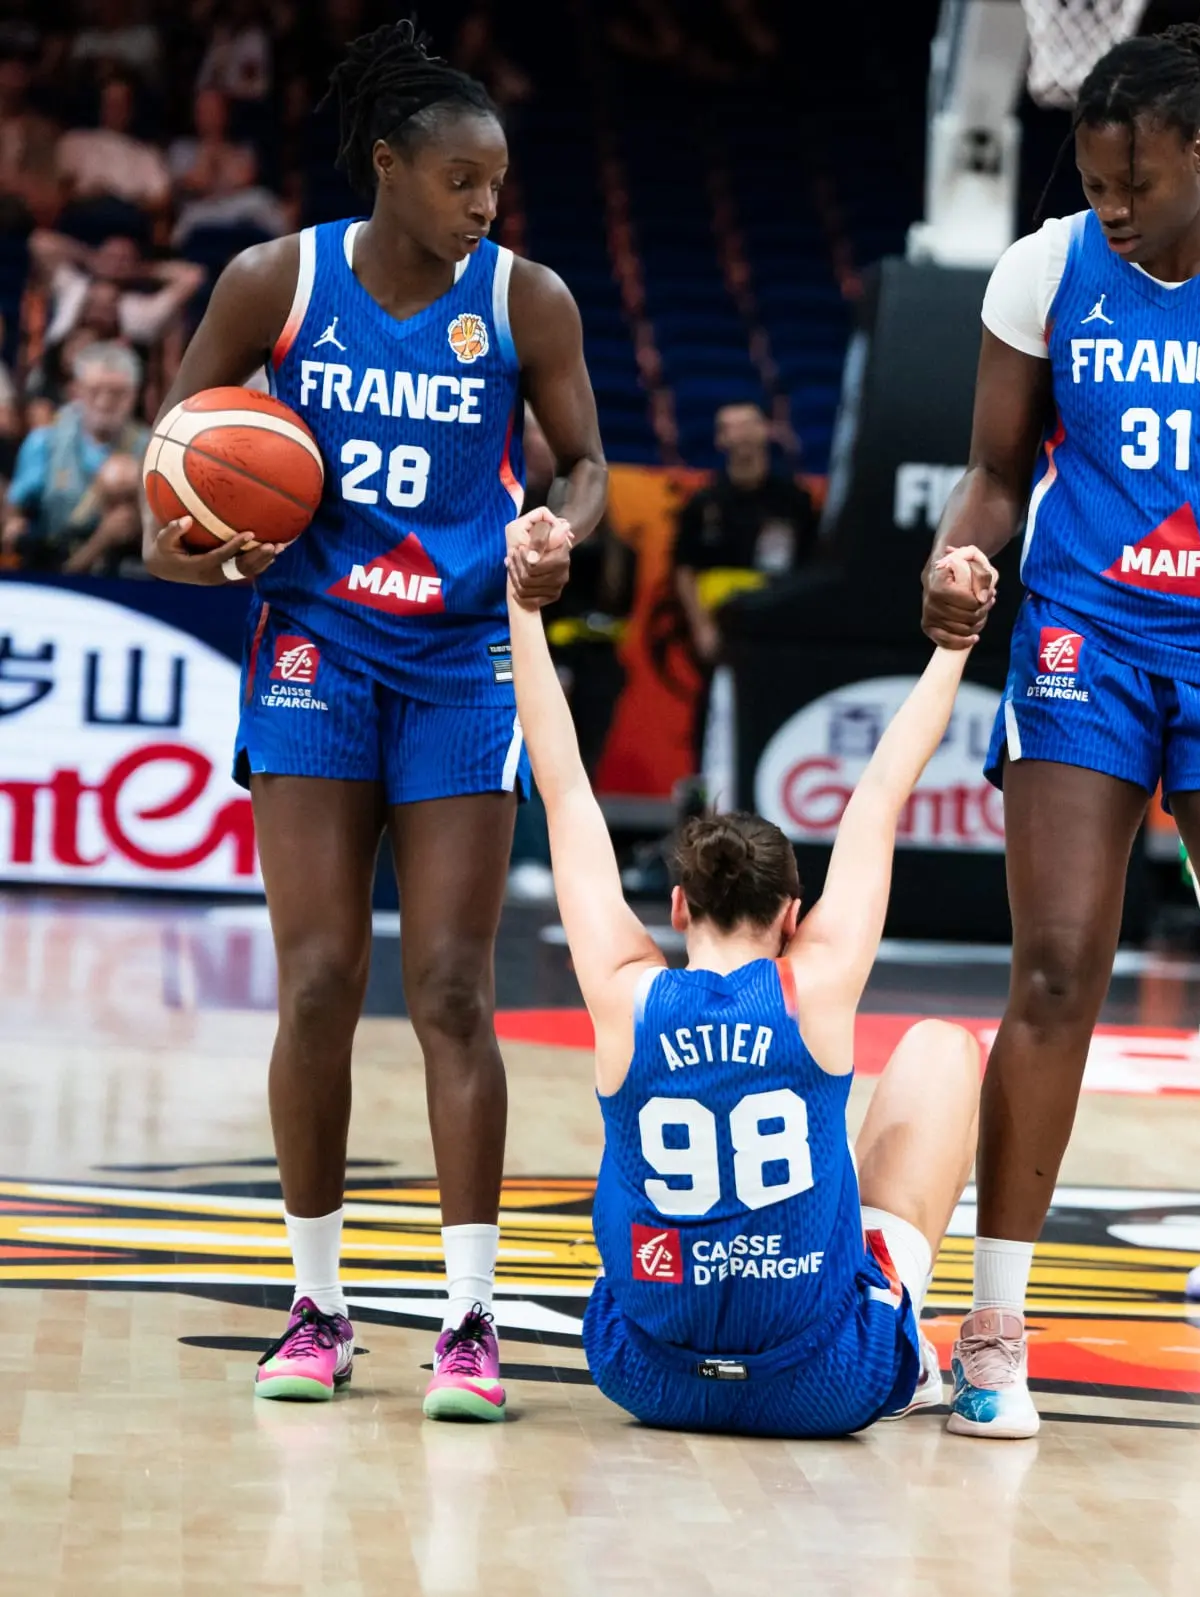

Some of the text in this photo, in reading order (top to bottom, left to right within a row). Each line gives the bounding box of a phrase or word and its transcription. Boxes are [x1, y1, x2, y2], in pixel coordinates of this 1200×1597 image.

[300, 360, 485, 424] FRANCE
[1121, 407, 1192, 471] 31
[340, 438, 431, 508] 28
[348, 564, 442, 603] MAIF
[270, 684, 313, 698] CAISSE
[1027, 686, 1089, 702] D'EPARGNE
[1035, 674, 1075, 688] CAISSE
[659, 1023, 773, 1071] ASTIER
[638, 1088, 815, 1216] 98
[691, 1234, 782, 1272] CAISSE
[693, 1251, 825, 1286] D'EPARGNE
